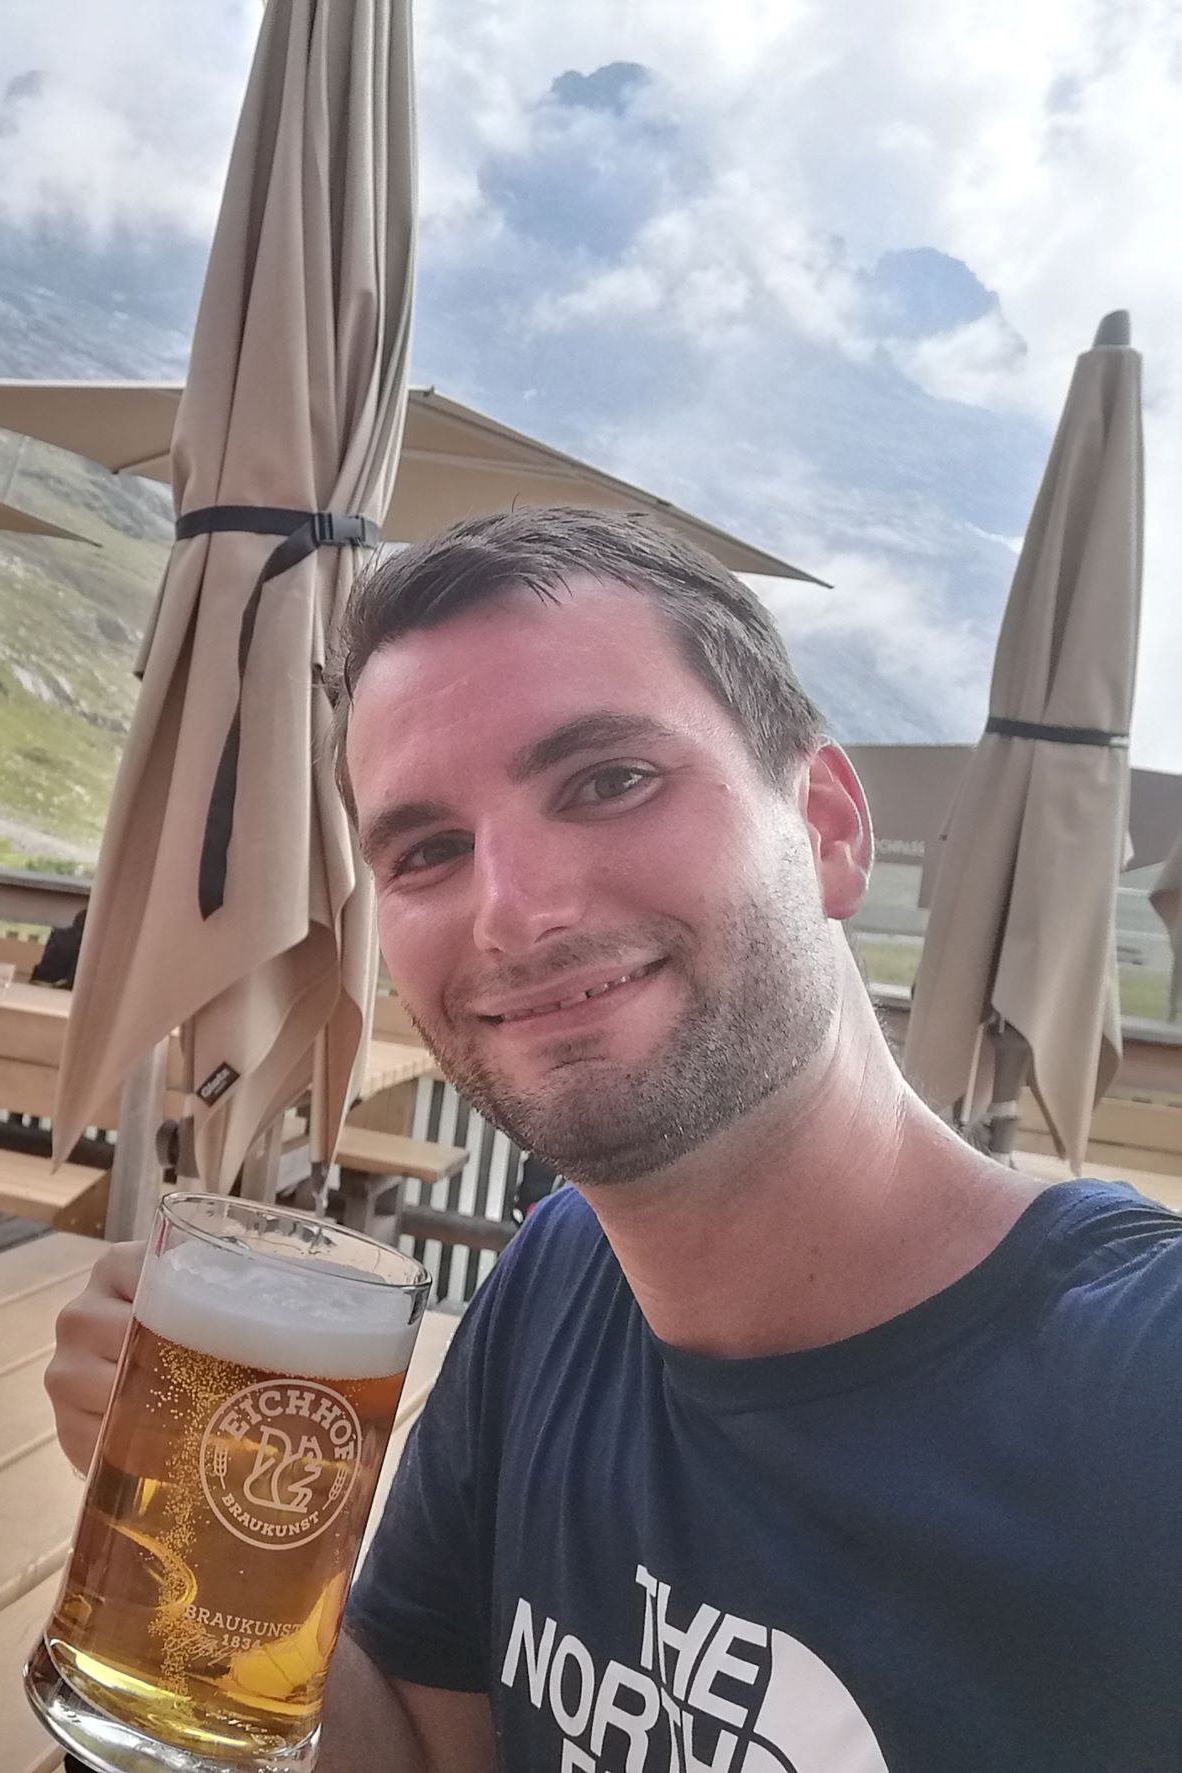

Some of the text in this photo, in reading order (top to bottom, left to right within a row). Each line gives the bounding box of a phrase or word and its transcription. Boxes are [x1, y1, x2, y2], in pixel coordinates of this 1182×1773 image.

[218, 1389, 356, 1462] EICHHOF
[221, 1493, 319, 1537] BRAUKUNST
[183, 1604, 303, 1638] BRAUKUNST
[221, 1633, 261, 1650] 1834
[635, 1563, 768, 1729] THE
[500, 1597, 739, 1773] NORTH
